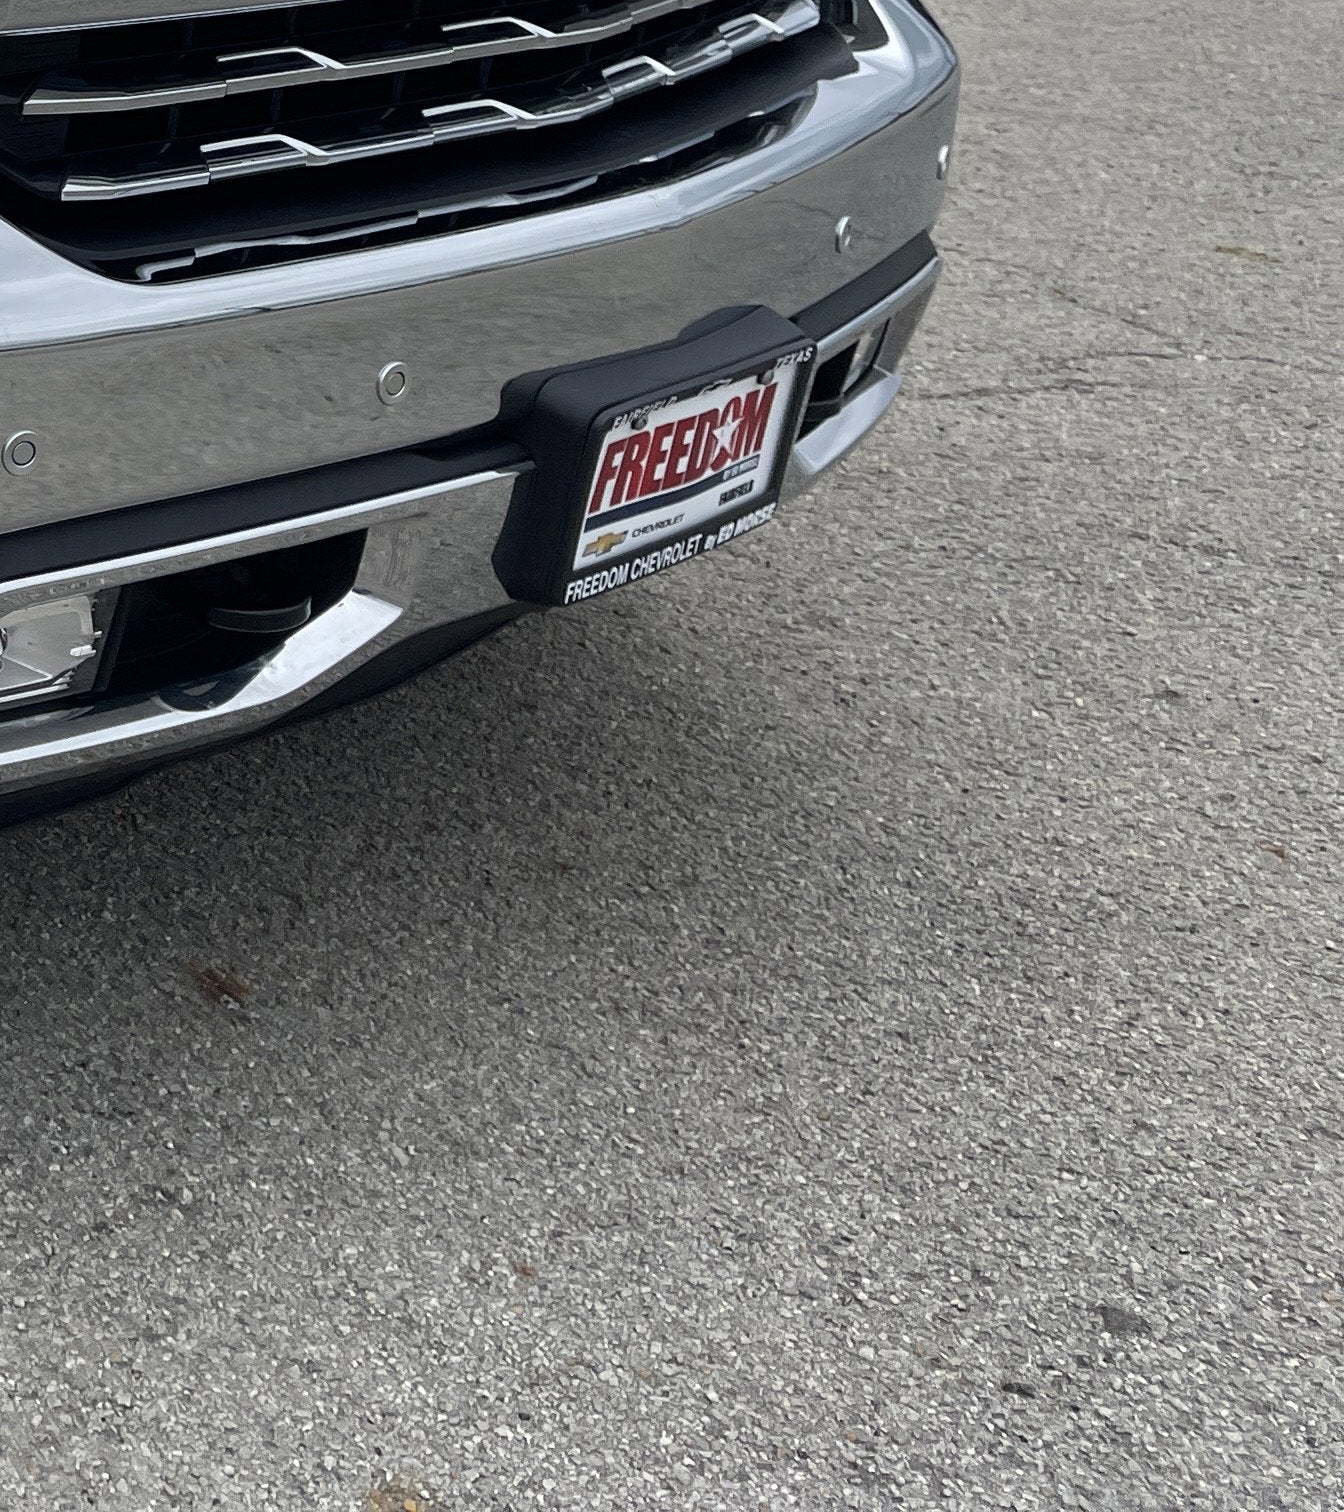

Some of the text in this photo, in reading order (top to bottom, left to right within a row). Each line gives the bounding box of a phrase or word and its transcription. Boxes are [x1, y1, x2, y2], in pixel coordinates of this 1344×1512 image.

[631, 513, 685, 538] CHEVROLET
[564, 561, 630, 605] FREEDOM
[629, 533, 703, 581] CHEVROLET
